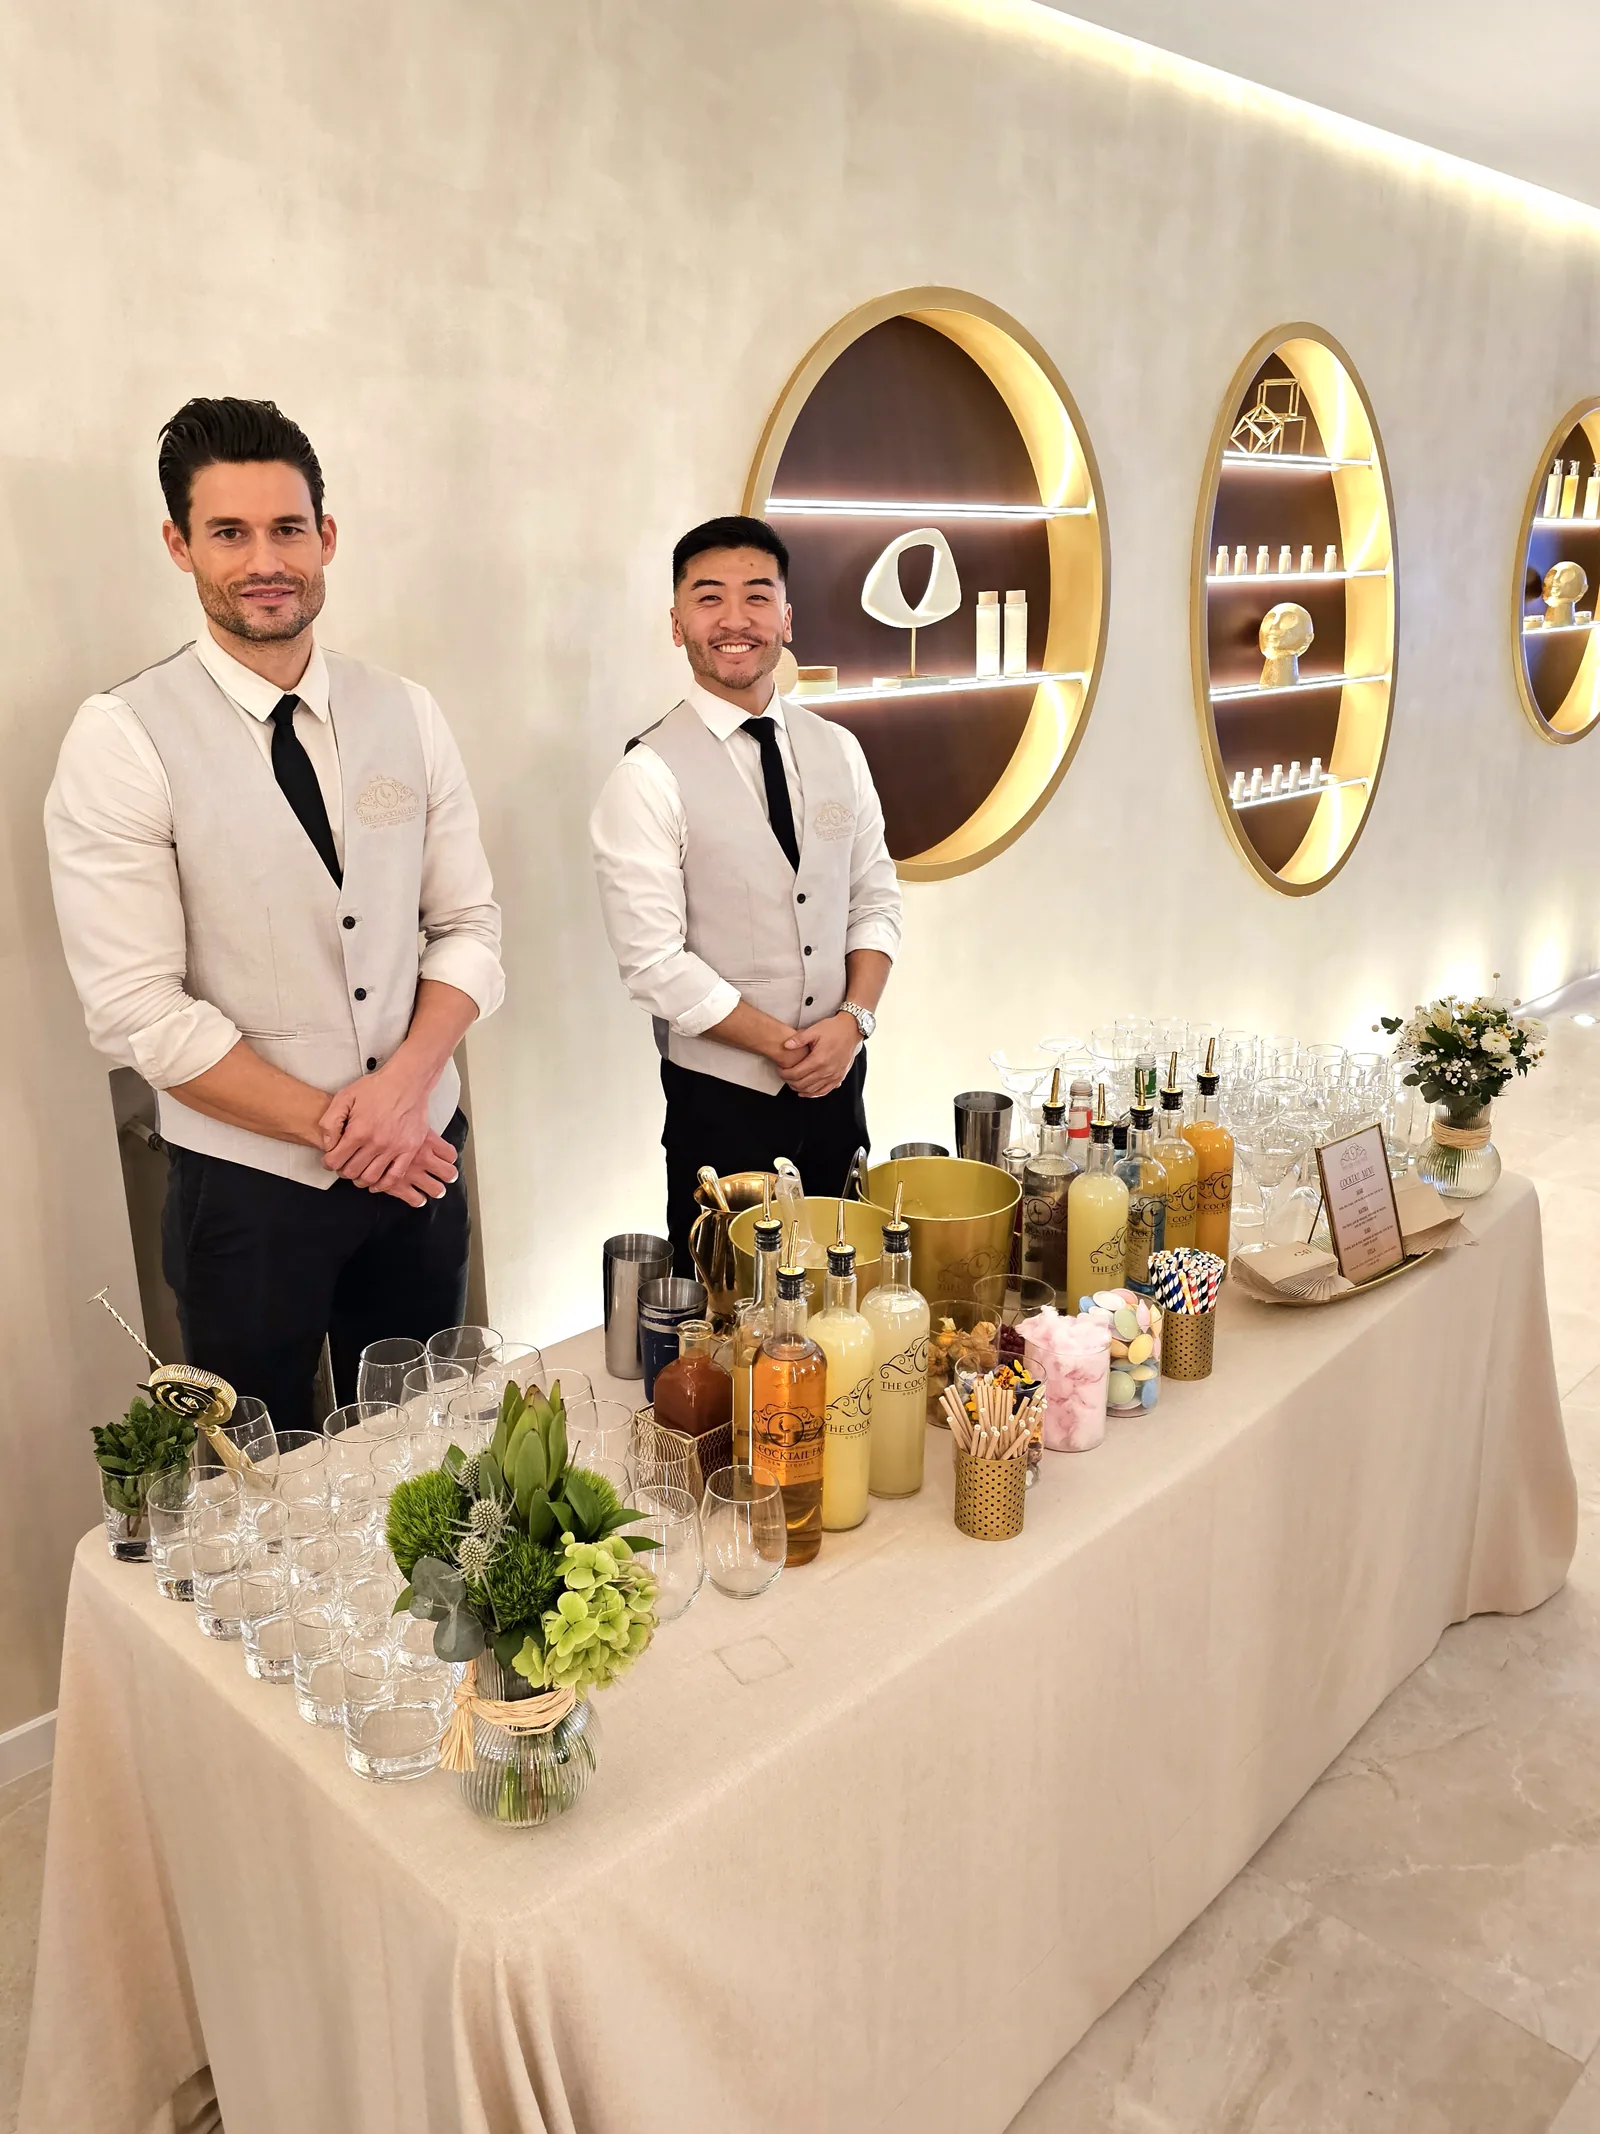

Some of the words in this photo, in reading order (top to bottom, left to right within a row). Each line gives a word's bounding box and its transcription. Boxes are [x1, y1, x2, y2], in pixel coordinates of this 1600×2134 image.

[880, 1381, 901, 1390] THE
[824, 1423, 844, 1433] THE
[758, 1444, 808, 1461] COCKTAIL
